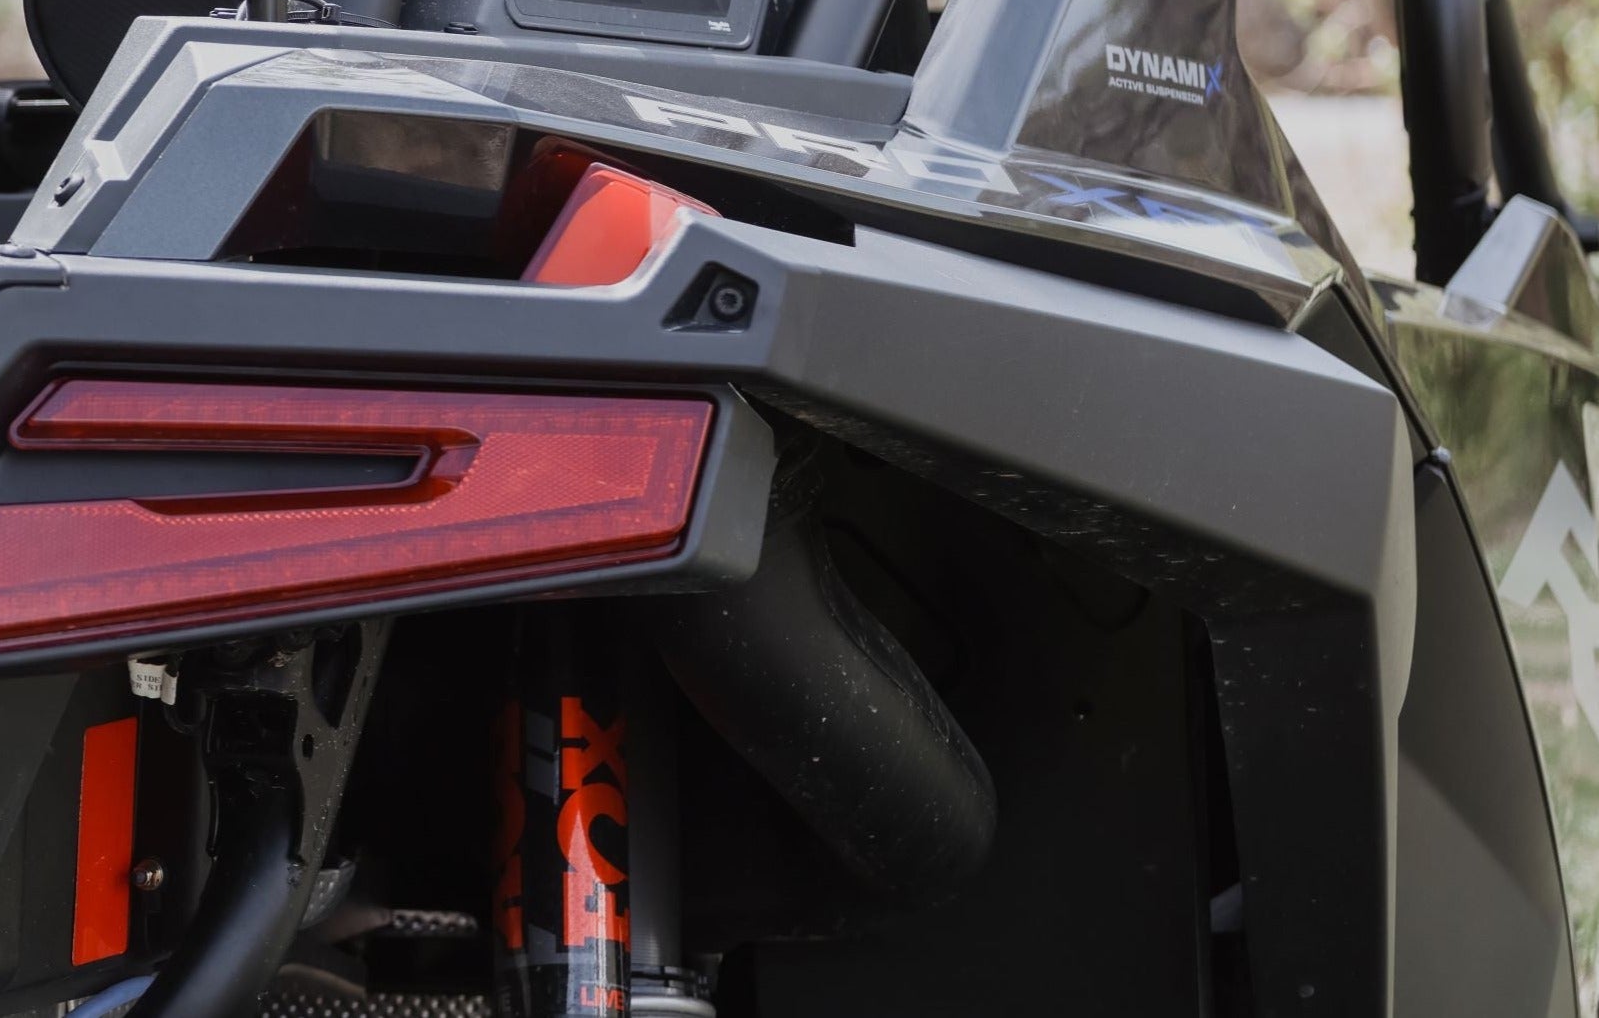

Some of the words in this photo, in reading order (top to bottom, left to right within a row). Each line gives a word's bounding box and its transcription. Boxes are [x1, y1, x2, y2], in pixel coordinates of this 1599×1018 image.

[1106, 44, 1223, 99] DYNAMIX
[1108, 75, 1145, 93] ACTIVE
[1145, 82, 1205, 106] SUSPENSION
